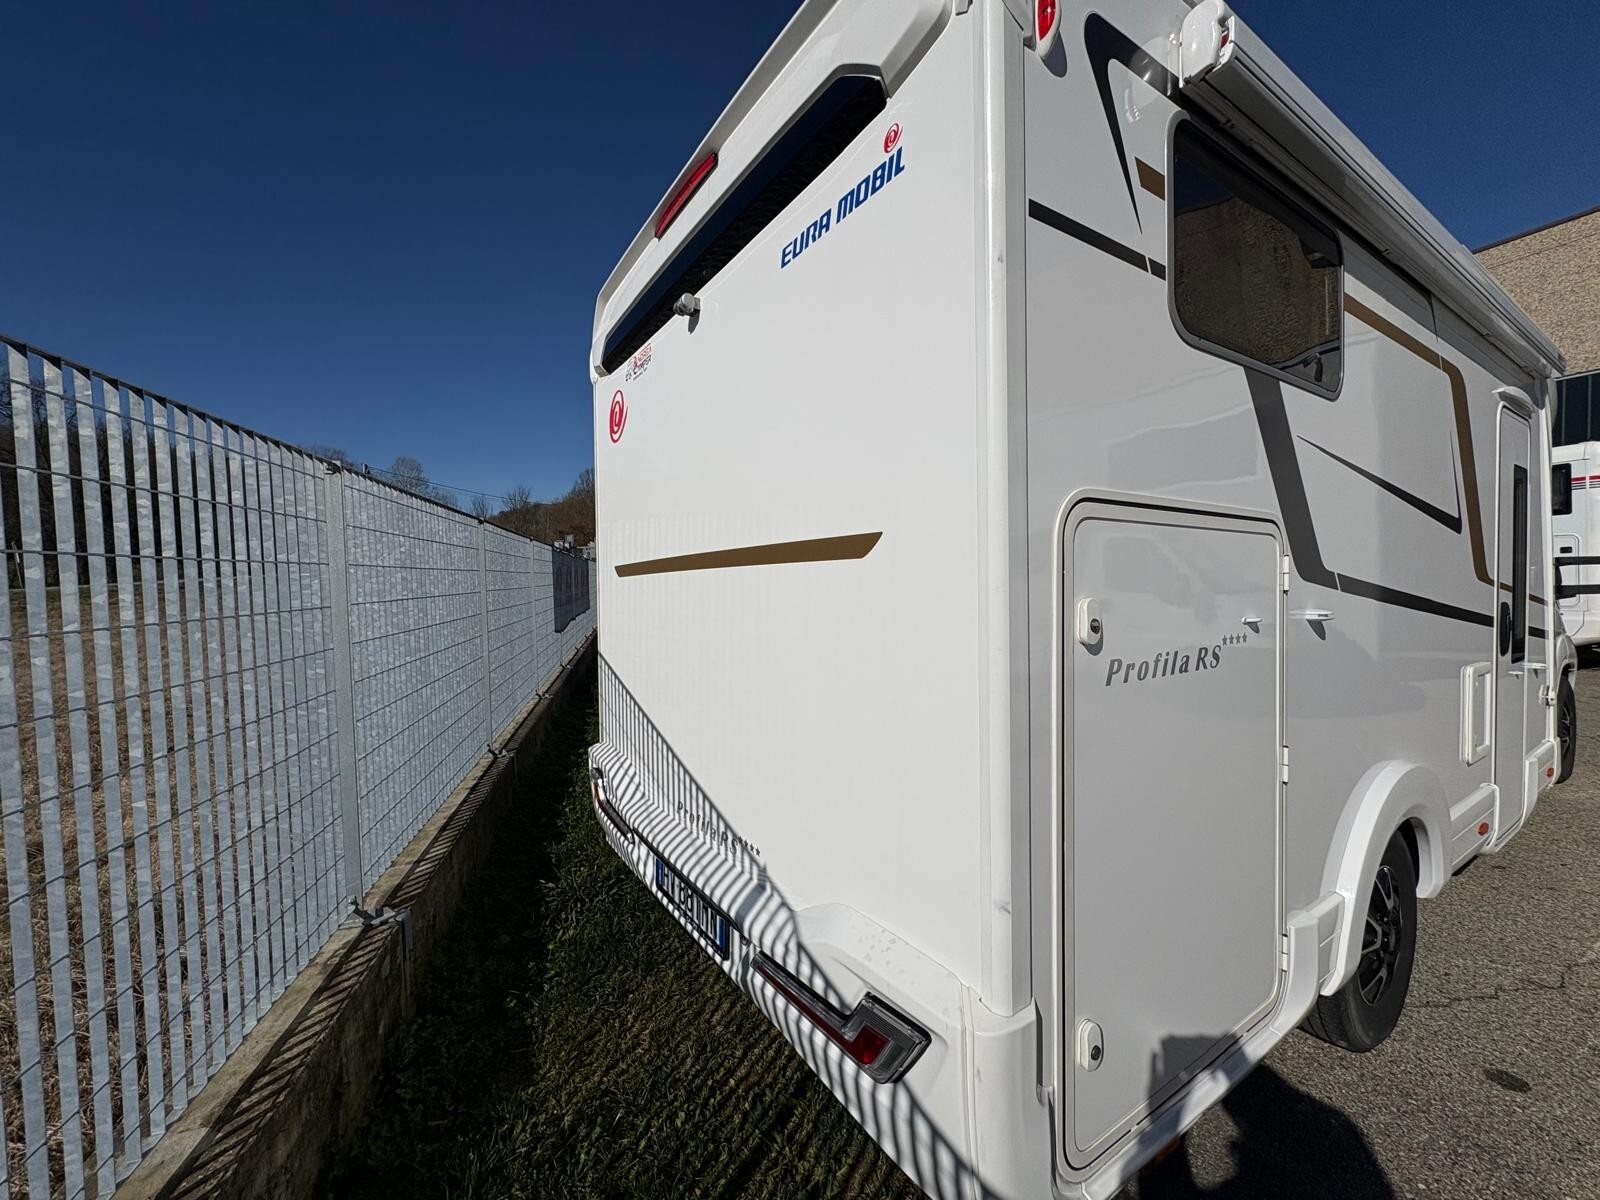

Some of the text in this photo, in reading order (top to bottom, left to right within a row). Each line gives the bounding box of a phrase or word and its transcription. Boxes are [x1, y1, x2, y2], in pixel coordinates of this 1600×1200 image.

[781, 146, 905, 269] EURA MOBIL
[1105, 644, 1222, 687] Profila RS
